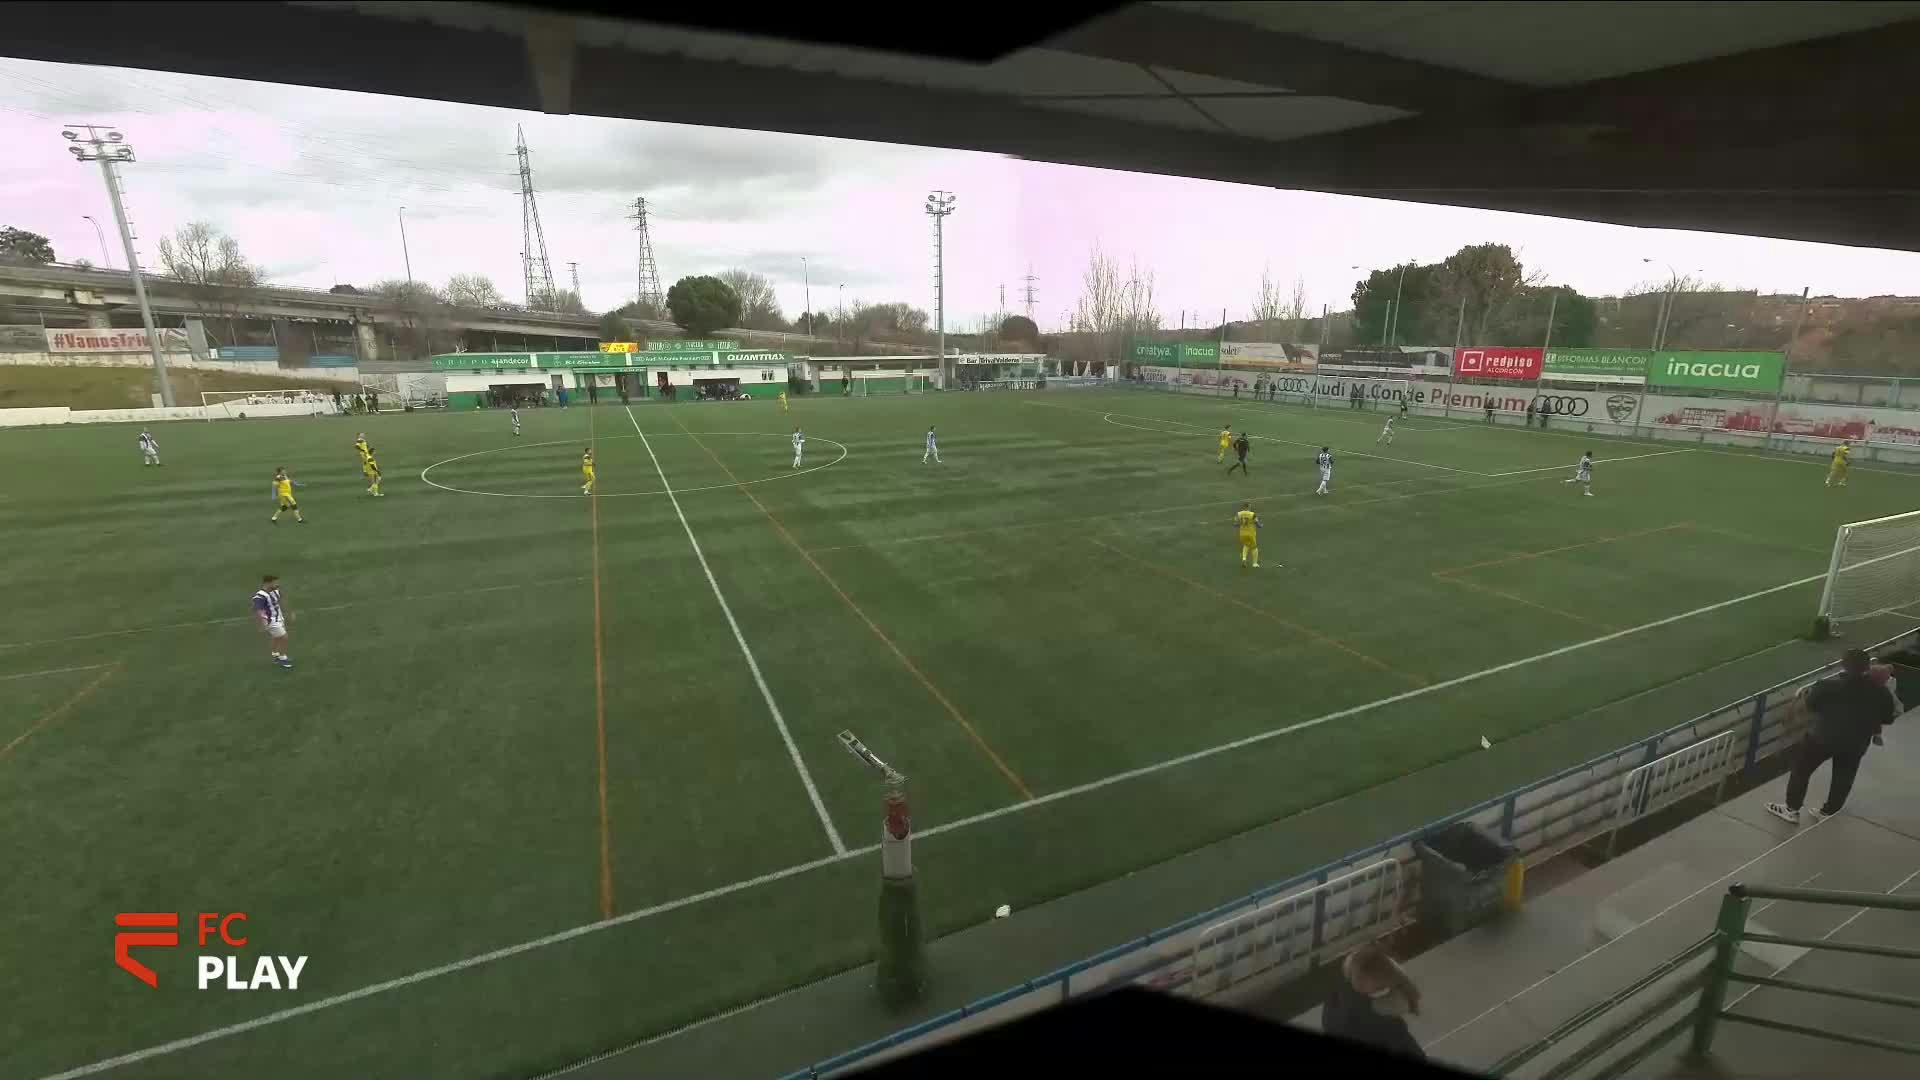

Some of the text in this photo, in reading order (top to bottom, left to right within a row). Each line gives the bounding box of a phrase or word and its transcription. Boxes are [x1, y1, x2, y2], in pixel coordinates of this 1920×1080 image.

[54, 333, 164, 349] #VamosTrivl
[1185, 345, 1214, 356] inacua
[491, 356, 529, 368] ajandecor
[1486, 356, 1533, 368] redpiso
[1667, 357, 1762, 379] inacua
[1310, 381, 1345, 396] Audi
[1431, 388, 1525, 411] Premium
